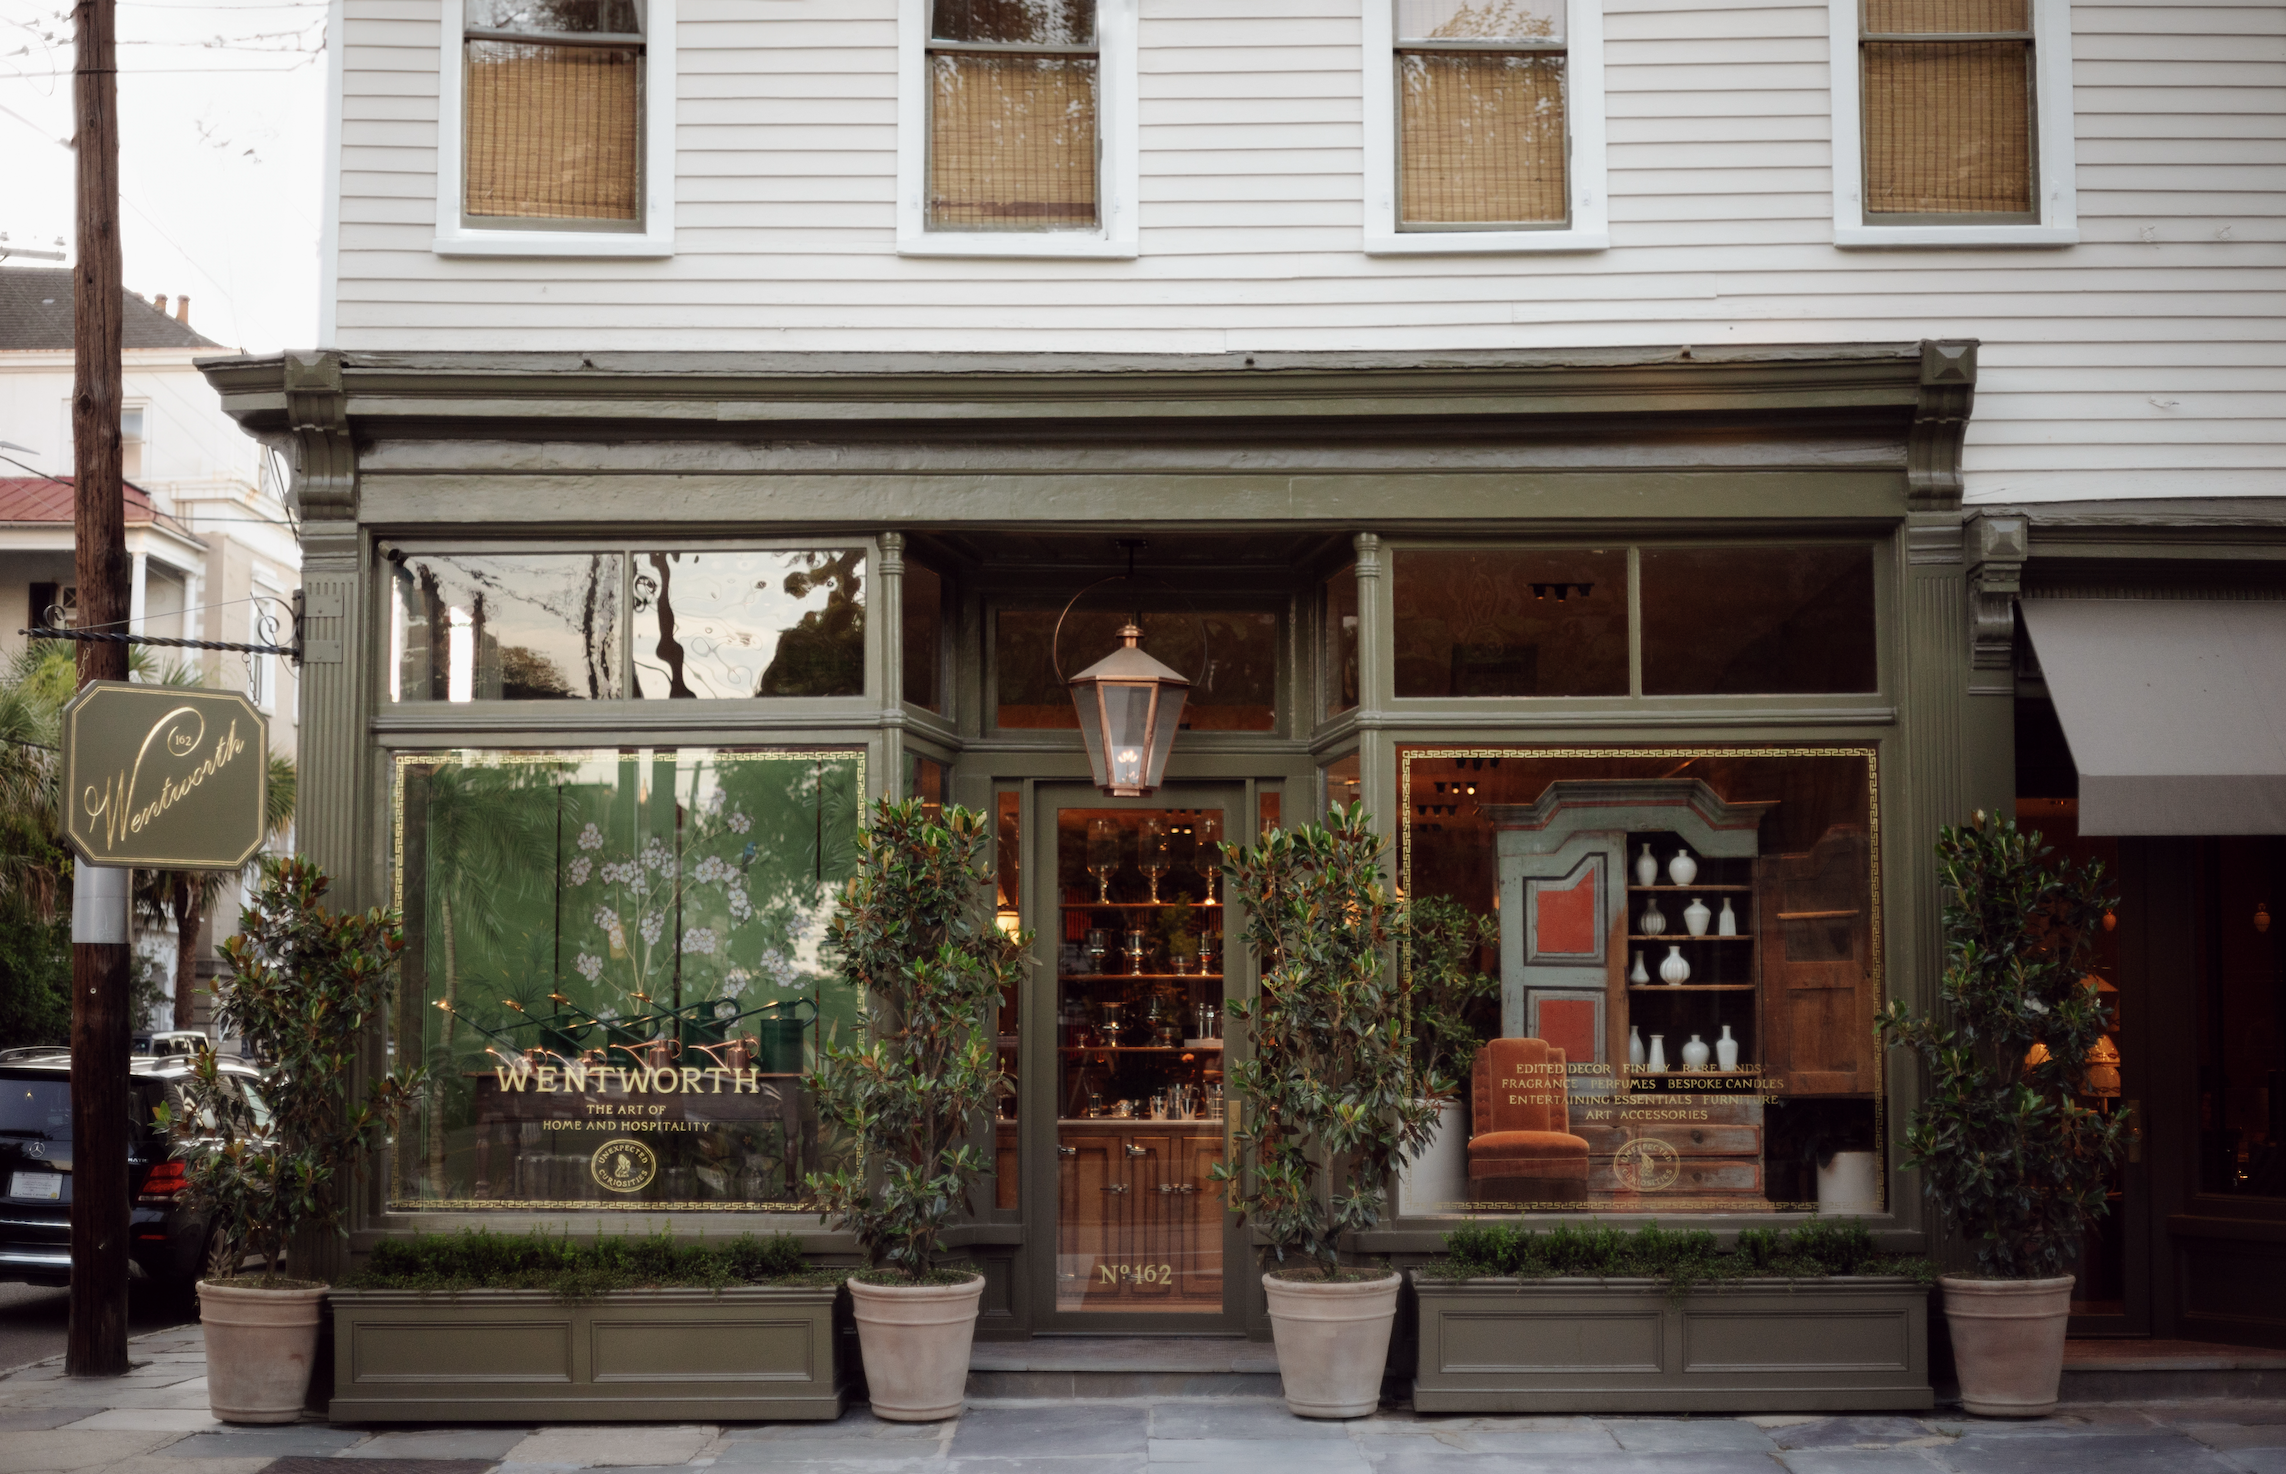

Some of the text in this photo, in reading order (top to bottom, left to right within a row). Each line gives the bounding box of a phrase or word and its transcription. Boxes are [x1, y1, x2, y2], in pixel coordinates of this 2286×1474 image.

[175, 734, 192, 747] 162
[84, 706, 244, 851] Wentworth
[1516, 1063, 1564, 1074] EDITED
[1568, 1063, 1611, 1074] DECOR
[1682, 1063, 1718, 1074] RARE
[495, 1066, 760, 1094] WENTWORTH
[1502, 1079, 1784, 1089] FRAGRANCE PERFUMES BESPOKE CANDLES
[1509, 1095, 1779, 1105] ENTERTAINING ESSENTIALS FURNITURE
[586, 1104, 667, 1115] THE ART OF
[1585, 1110, 1708, 1120] ART ACCESSORIES
[543, 1120, 711, 1132] HOME AND HOSPITALITY
[598, 1144, 648, 1164] UNEXPECTED
[1621, 1143, 1672, 1163] UNEXPECTED
[598, 1169, 648, 1187] CURIOSITIES
[1622, 1168, 1673, 1186] CURIOSITIES
